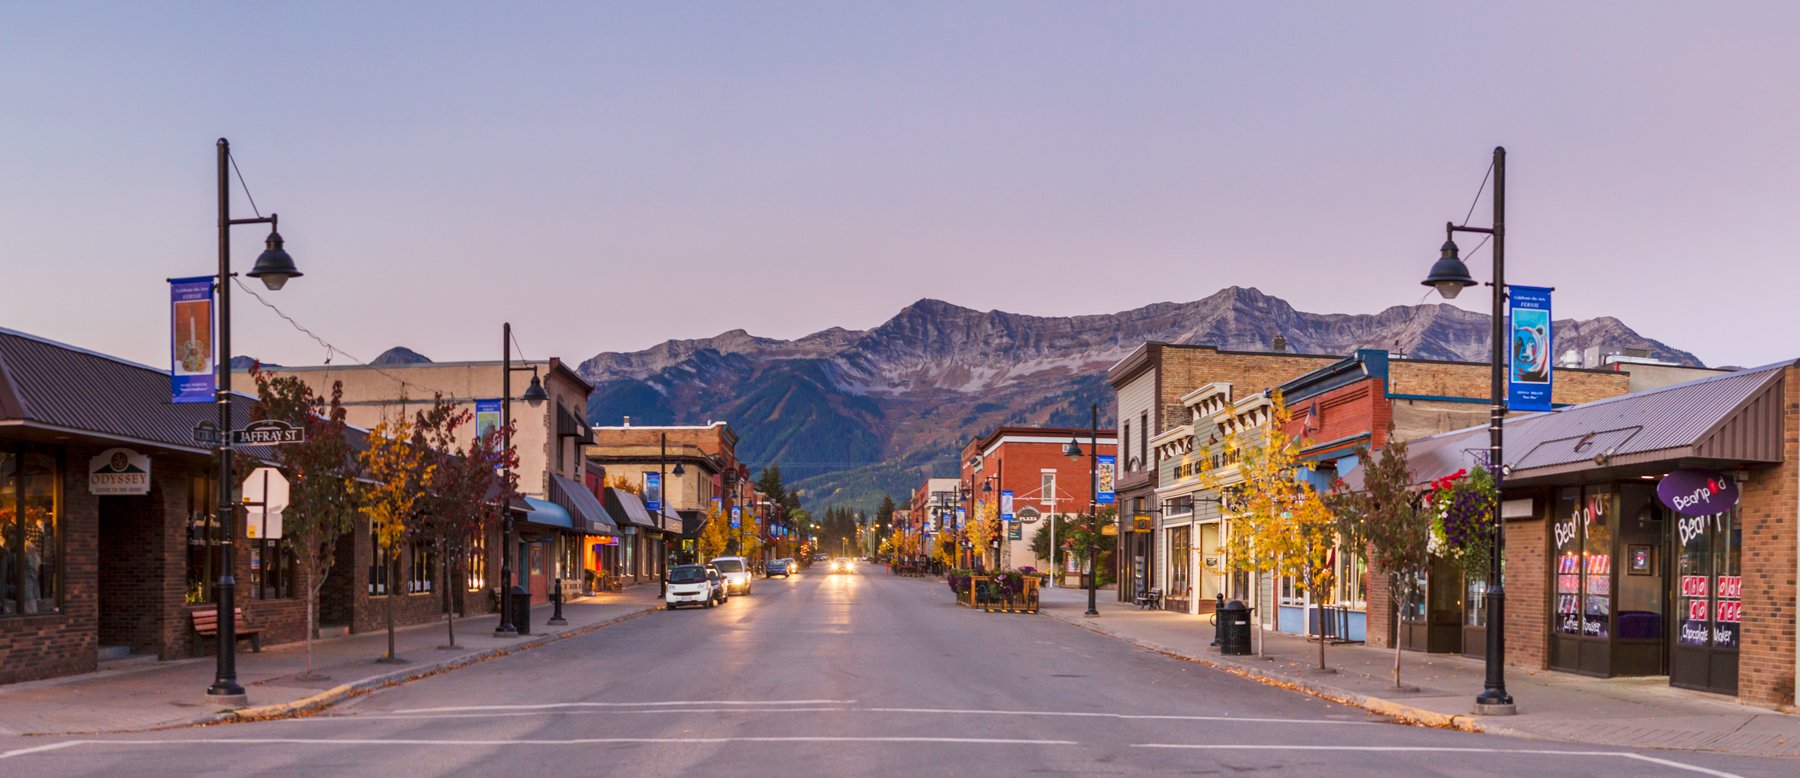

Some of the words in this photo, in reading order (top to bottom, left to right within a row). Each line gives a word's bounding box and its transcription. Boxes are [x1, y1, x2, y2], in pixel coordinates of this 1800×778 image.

[240, 430, 282, 442] JAFFRAY
[284, 429, 297, 440] ST
[91, 474, 147, 485] ODYSSEY
